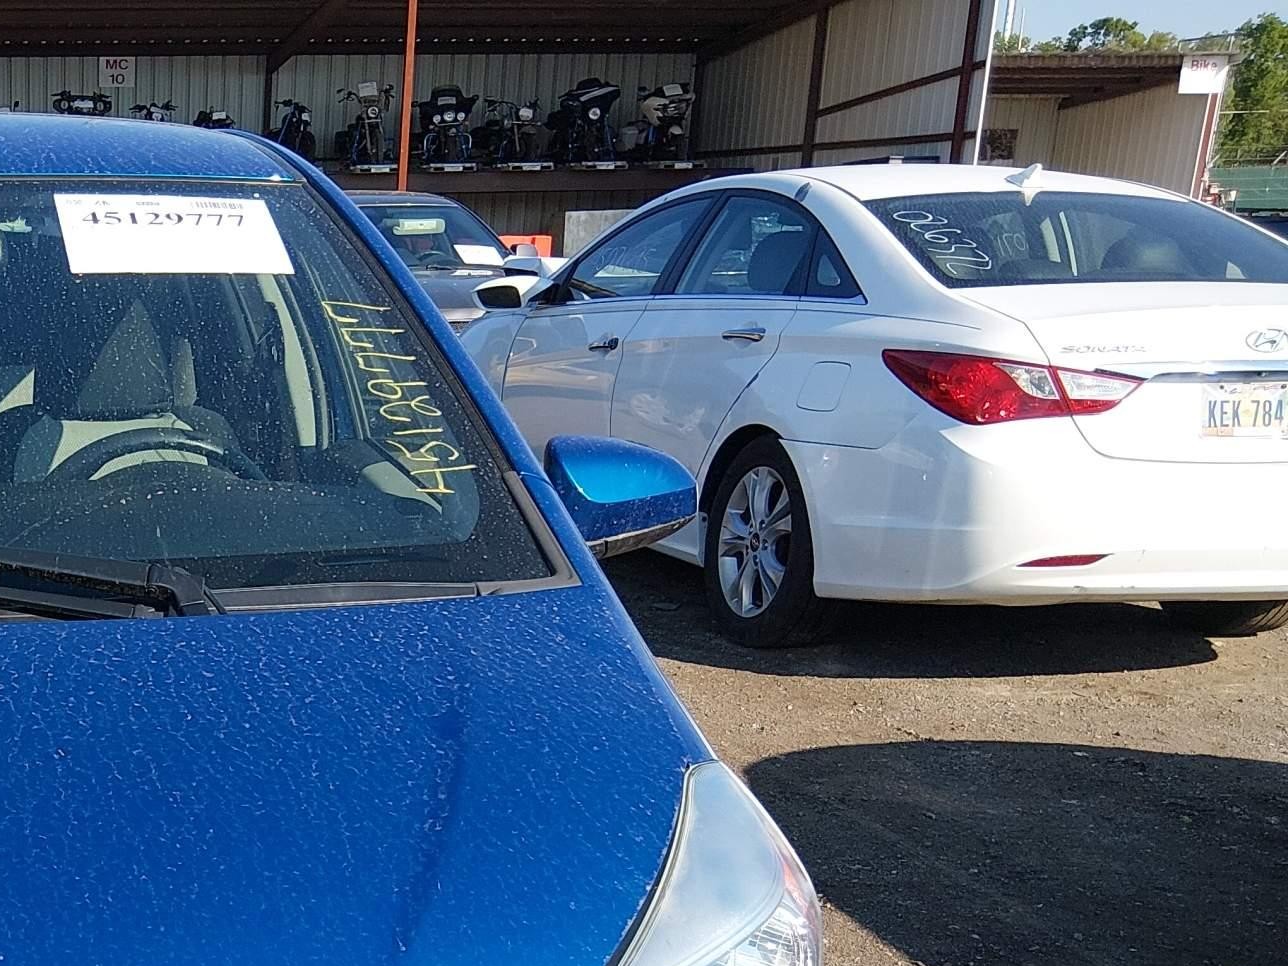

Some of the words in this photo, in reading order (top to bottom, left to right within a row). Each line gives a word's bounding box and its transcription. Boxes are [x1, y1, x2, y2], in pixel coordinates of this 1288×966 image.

[105, 59, 129, 70] MC
[1192, 60, 1218, 71] Bike
[109, 74, 126, 85] 10
[81, 211, 245, 227] 45129777
[322, 300, 478, 494] 45129777
[1208, 400, 1242, 428] KEK
[1251, 400, 1285, 428] 784
